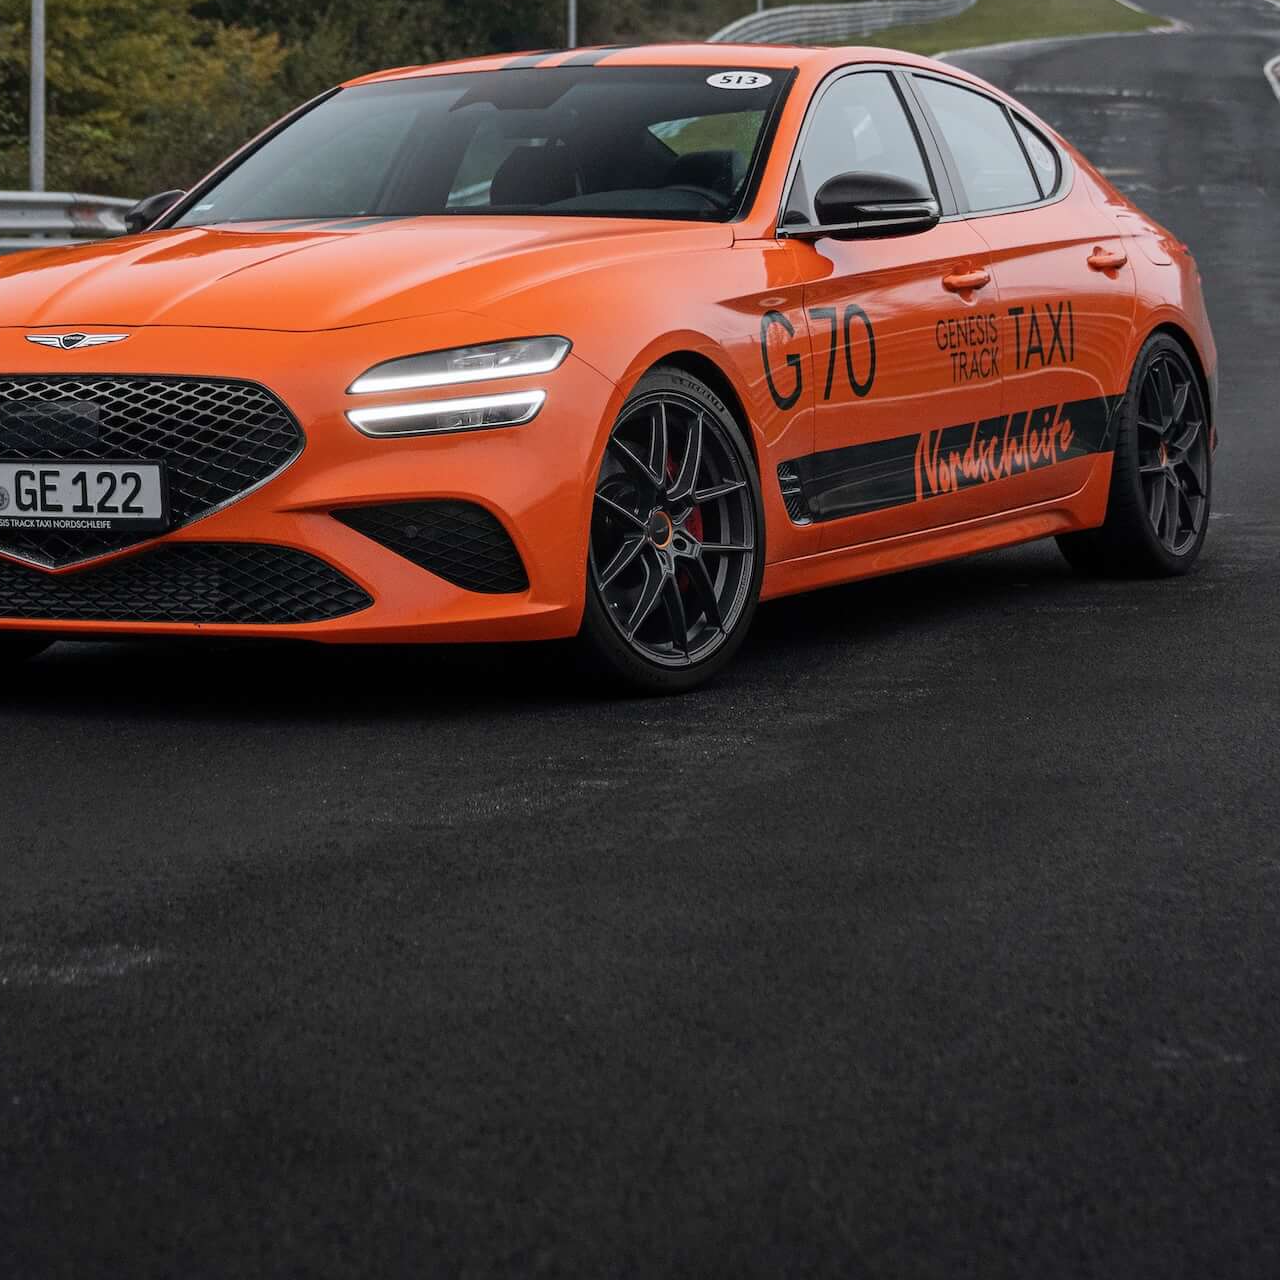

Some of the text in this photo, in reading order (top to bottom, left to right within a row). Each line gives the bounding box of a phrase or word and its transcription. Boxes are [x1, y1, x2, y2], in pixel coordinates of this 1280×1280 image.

[720, 75, 759, 85] 513
[935, 313, 998, 351] GENESIS
[1008, 300, 1075, 370] TAXI
[950, 346, 1000, 384] TRACK
[914, 403, 1074, 501] Nordschleife
[14, 469, 64, 512] GE
[72, 471, 144, 514] 122
[11, 518, 35, 528] TRACK
[35, 519, 52, 528] TAXI
[53, 520, 112, 529] NORDSCHLEIFE
